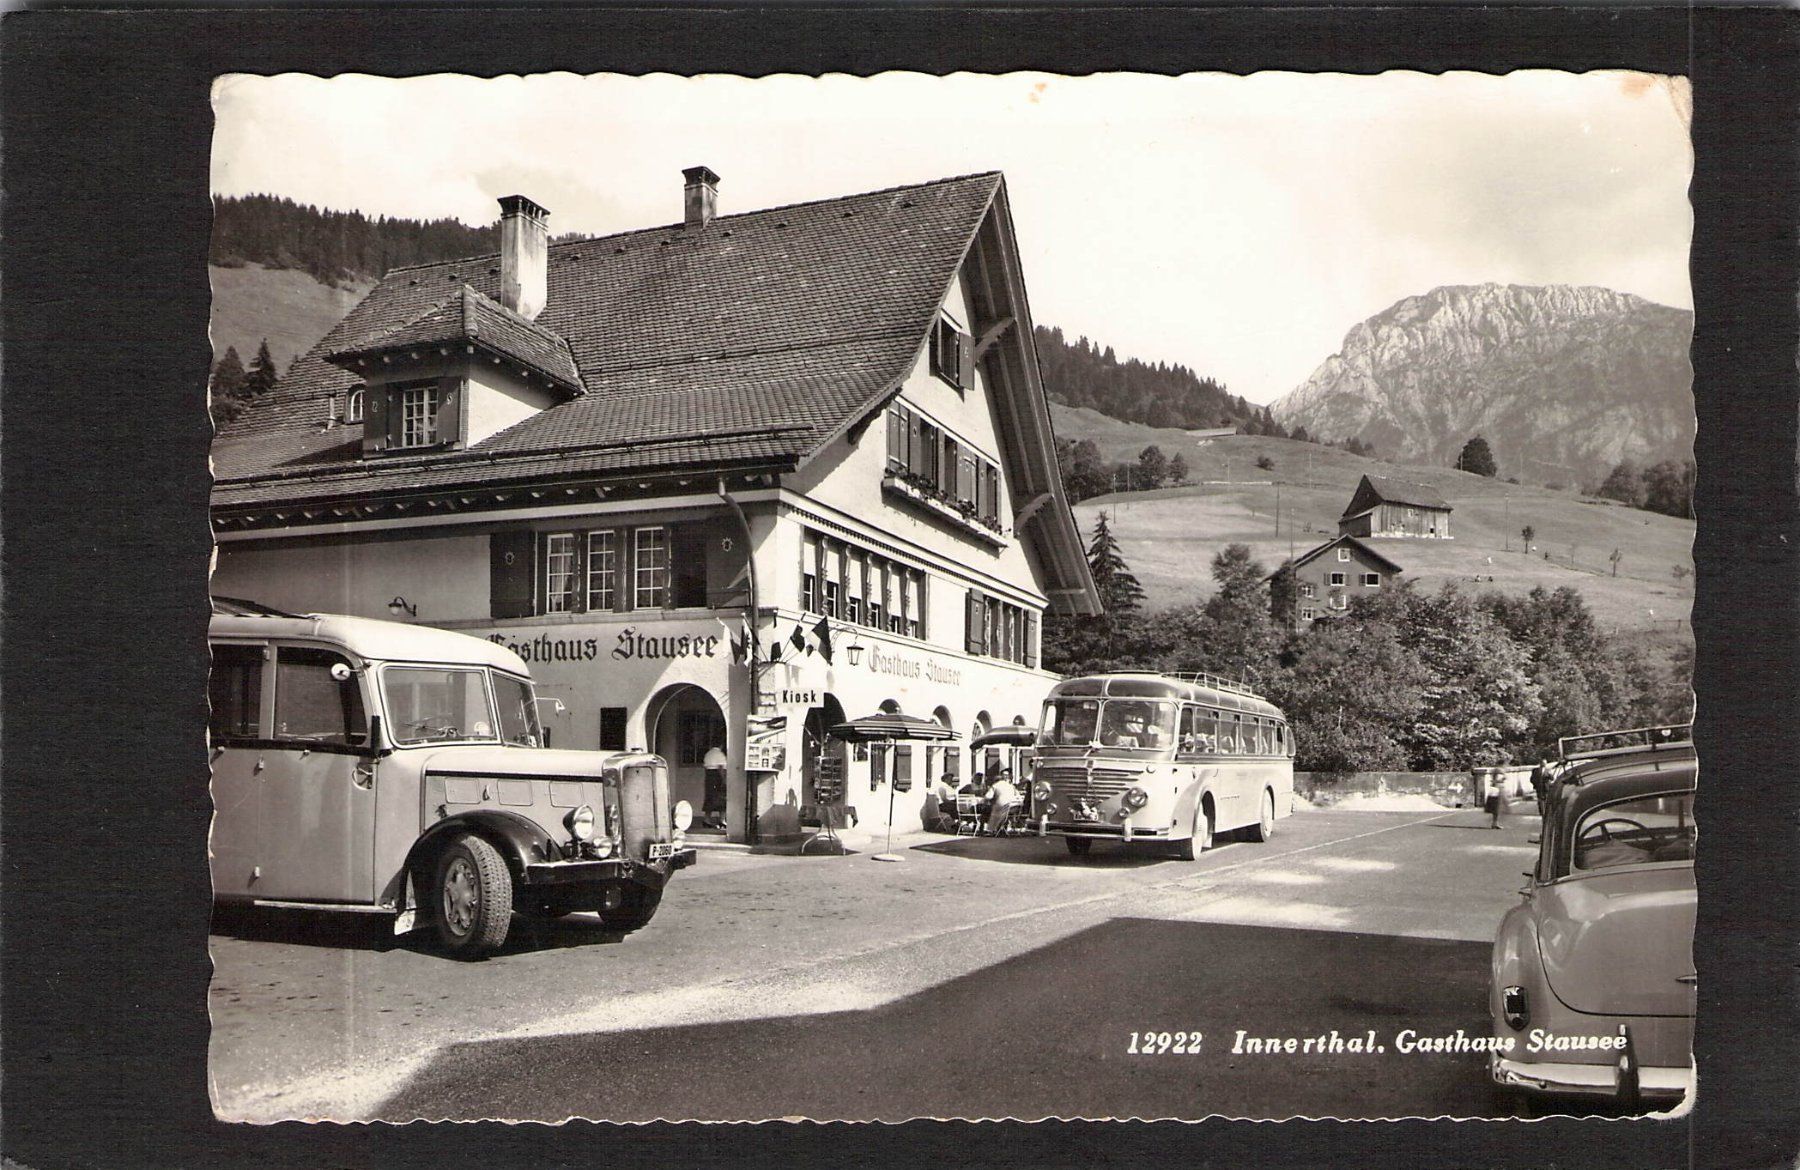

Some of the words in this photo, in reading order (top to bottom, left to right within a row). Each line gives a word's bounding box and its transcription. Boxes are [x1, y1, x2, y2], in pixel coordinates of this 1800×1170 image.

[611, 626, 719, 660] Stausee
[868, 645, 920, 679] Gasthaus
[925, 657, 961, 687] Stausee
[782, 689, 816, 703] Kiosk
